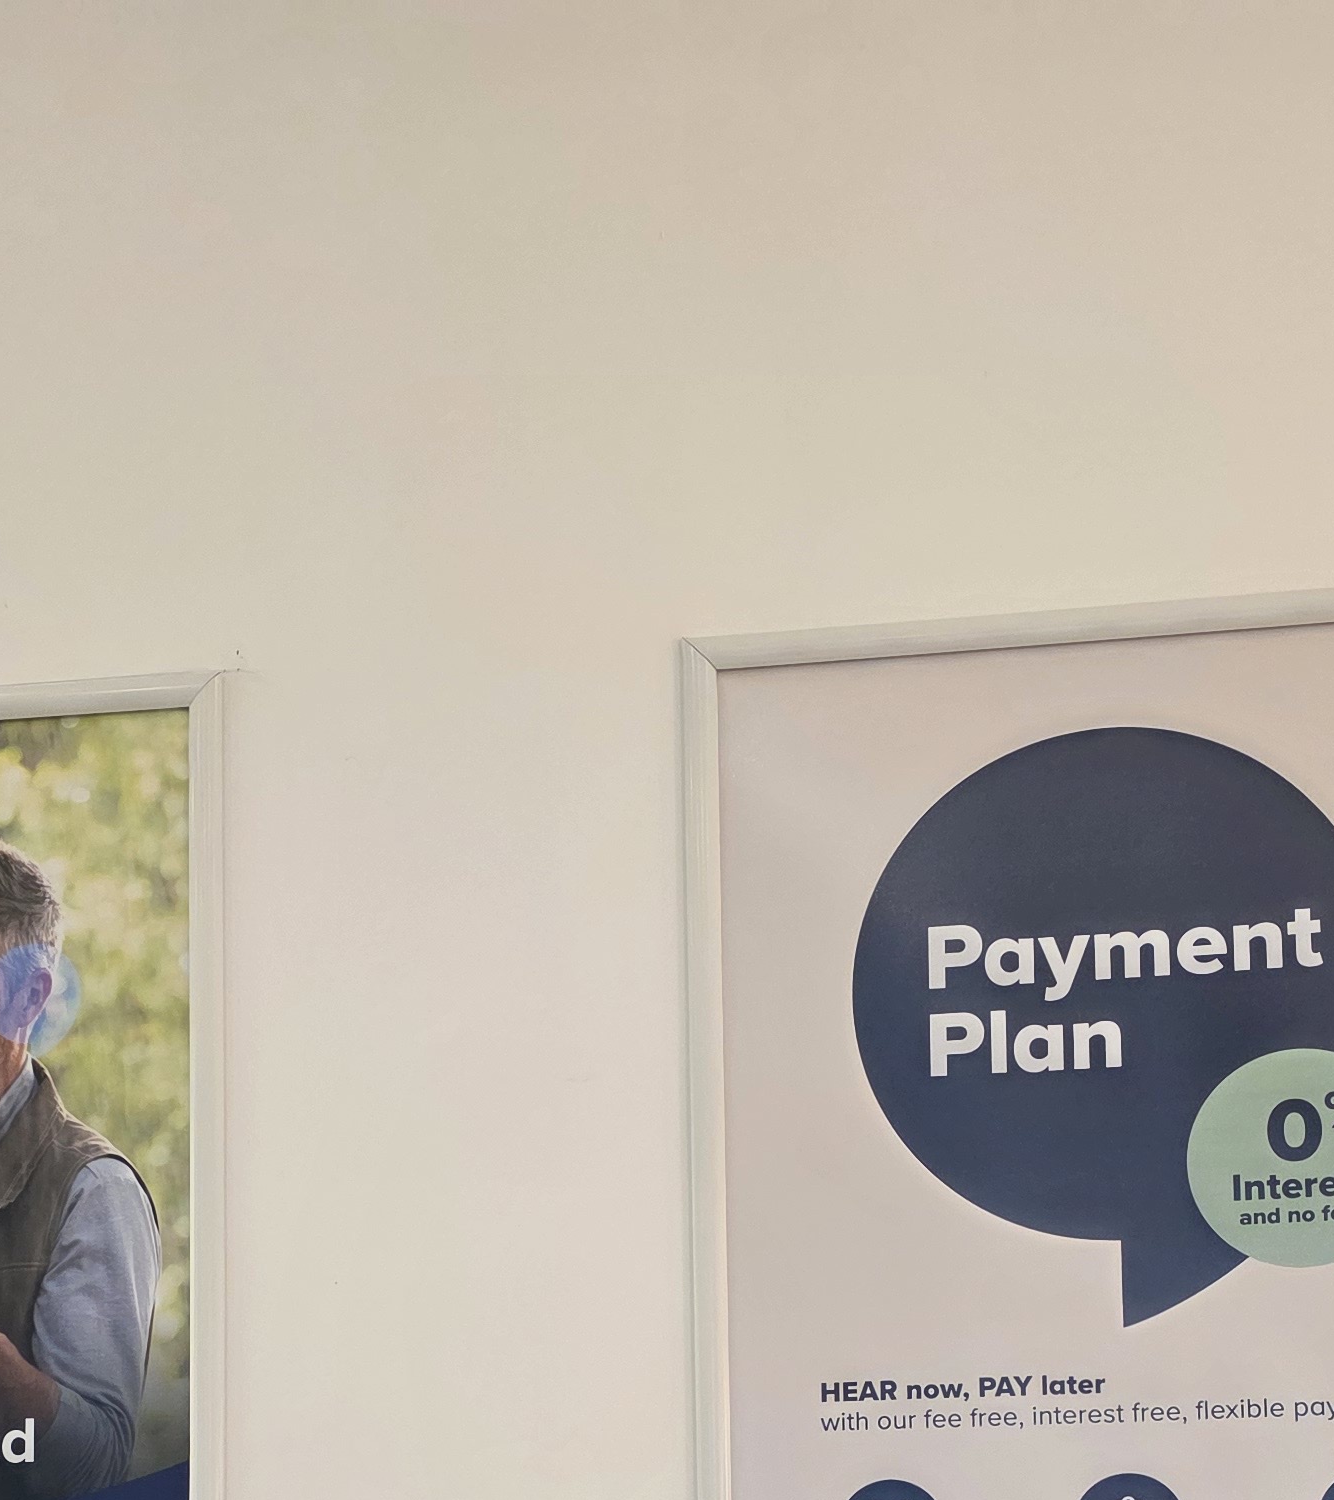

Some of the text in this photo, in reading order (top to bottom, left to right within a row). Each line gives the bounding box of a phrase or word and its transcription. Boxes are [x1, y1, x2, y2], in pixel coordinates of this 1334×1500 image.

[928, 908, 1323, 1001] Payment
[929, 1010, 1122, 1077] Plan
[1240, 1207, 1280, 1225] and
[1288, 1210, 1315, 1223] no
[821, 1375, 1106, 1403] HEAR now, PAY later
[821, 1412, 868, 1431] with
[878, 1415, 916, 1430] our
[924, 1409, 961, 1429] fee
[970, 1408, 1023, 1429] free,
[1033, 1405, 1124, 1425] interest
[1132, 1402, 1187, 1424] free,
[1195, 1398, 1284, 1420] flexible
